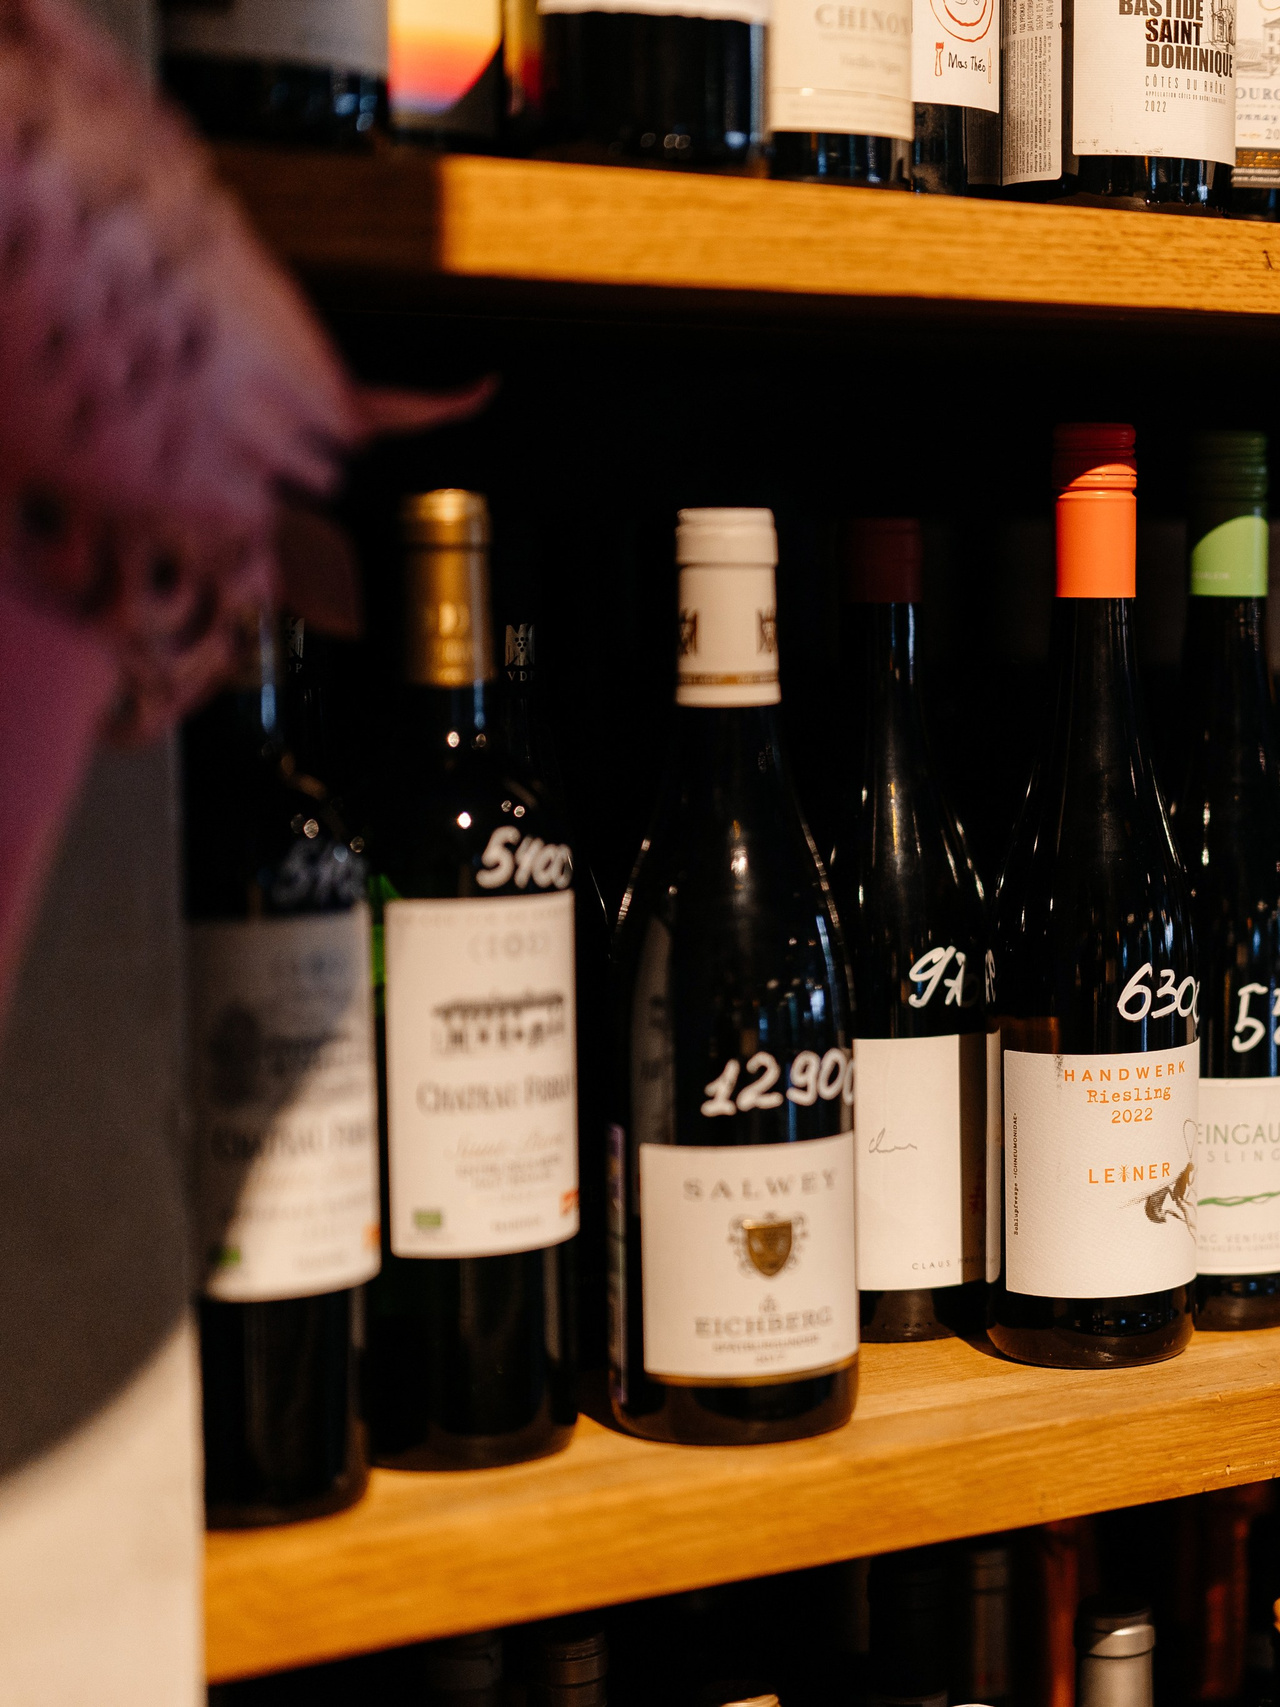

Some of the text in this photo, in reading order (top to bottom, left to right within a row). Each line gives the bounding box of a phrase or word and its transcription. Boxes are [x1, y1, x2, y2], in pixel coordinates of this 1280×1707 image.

[1119, 0, 1203, 21] BASTIDE
[1145, 18, 1203, 46] SAINT
[948, 52, 986, 73] Mas Théo
[1146, 43, 1233, 78] DOMINIQUE
[1145, 74, 1226, 96] CÔTES DU RHÔNE
[1145, 100, 1167, 113] 2022
[1064, 1060, 1186, 1083] HANDWERK
[1086, 1085, 1172, 1104] Riesling
[1111, 1107, 1154, 1124] 2022
[682, 1167, 838, 1201] SALWEY
[912, 1259, 952, 1271] CLAUS
